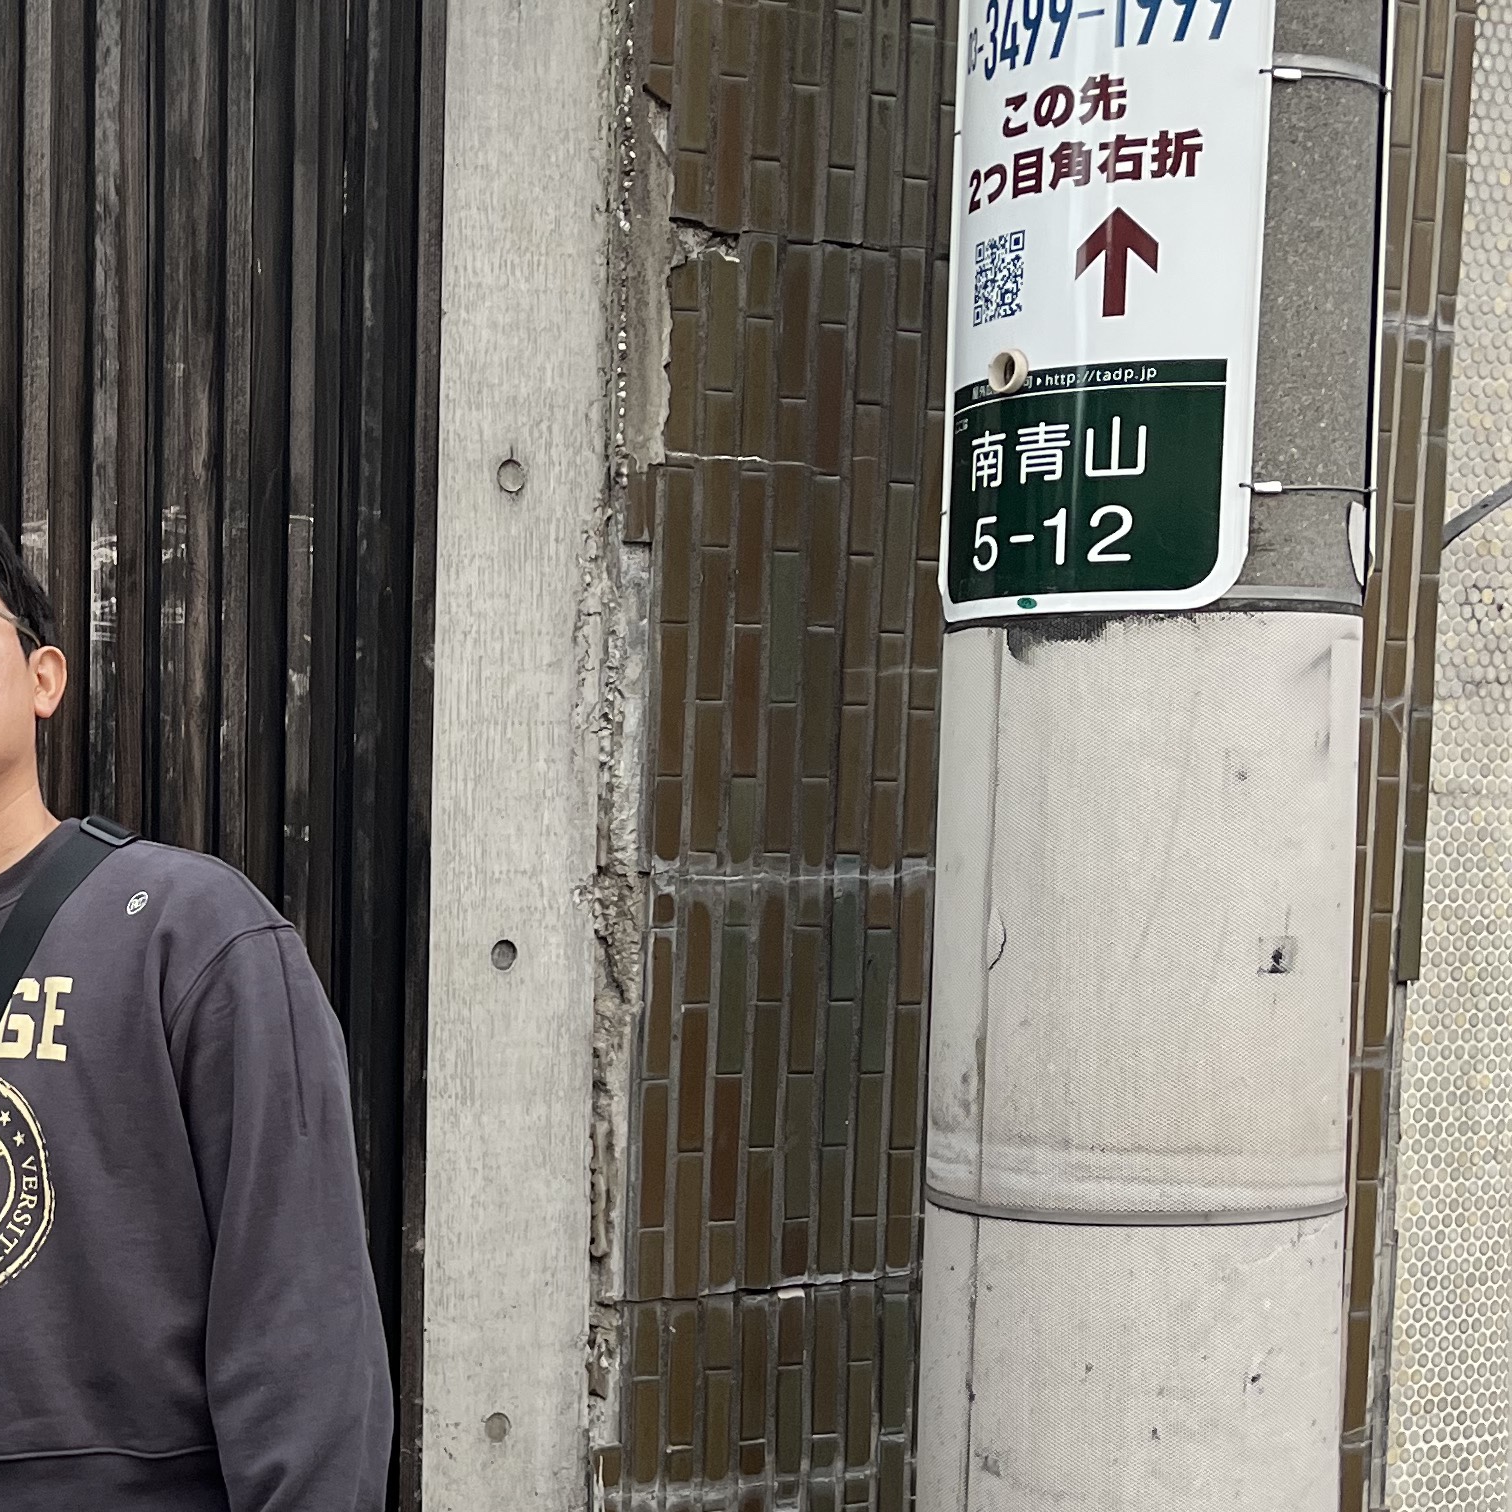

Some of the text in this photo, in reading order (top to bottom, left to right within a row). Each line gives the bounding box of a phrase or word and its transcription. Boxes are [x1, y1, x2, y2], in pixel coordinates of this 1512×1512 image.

[1002, 73, 1128, 138] この先
[968, 128, 1204, 215] 2つ目角右折
[1044, 366, 1157, 387] http://tadp.jp
[971, 415, 1147, 492] 南青山
[973, 503, 1133, 572] 5-12
